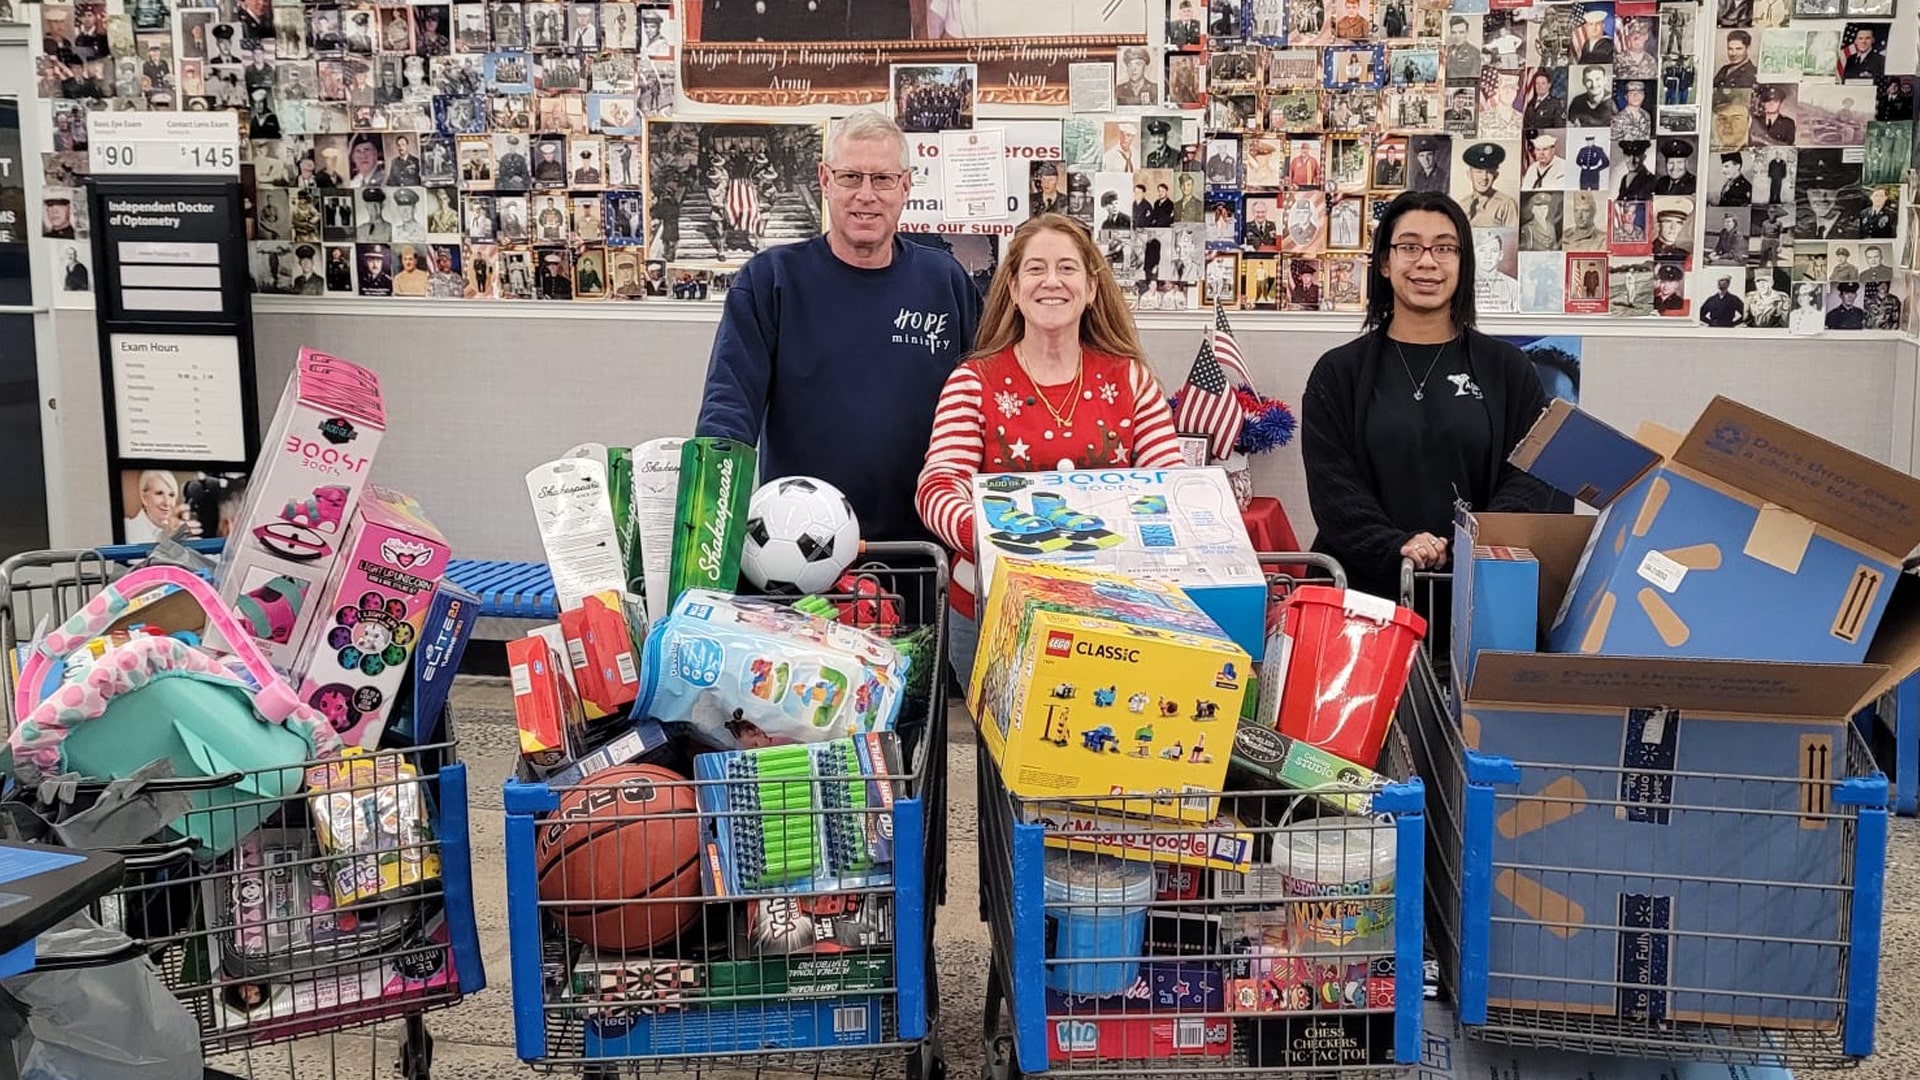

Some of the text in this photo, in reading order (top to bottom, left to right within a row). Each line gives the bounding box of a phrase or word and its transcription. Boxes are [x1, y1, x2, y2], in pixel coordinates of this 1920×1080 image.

[689, 49, 893, 72] Major Larry J. Bauguess, Jr.
[966, 43, 1087, 68] Chris Thompson
[769, 75, 812, 95] Army
[1007, 71, 1047, 93] Navy
[166, 120, 193, 129] Contact
[105, 146, 134, 166] 90
[191, 147, 234, 167] 145
[918, 142, 1061, 158] to eroes
[108, 200, 215, 214] Independent Doctor
[109, 214, 181, 229] of Optometry
[897, 222, 1014, 237] ave our supp
[894, 307, 950, 334] HOPE
[121, 341, 180, 353] Exam Hours
[892, 331, 951, 355] ministry
[641, 461, 681, 475] Shakesp
[1753, 437, 1910, 512] Don't throw away
[1759, 457, 1819, 488] chance
[1826, 485, 1844, 499] to
[538, 481, 600, 499] Shakespeare
[698, 457, 735, 581] Shakespeare
[359, 560, 385, 577] LIGHT
[395, 570, 433, 591] UNICORN
[422, 617, 455, 682] ELITE
[1049, 636, 1071, 650] LEGO
[1076, 641, 1141, 664] CLASSIC
[869, 737, 883, 774] REFILL
[1294, 757, 1335, 778] STUDIO
[880, 774, 893, 809] DAR
[1638, 773, 1651, 815] ontan
[1142, 829, 1208, 857] Doodle
[1635, 993, 1648, 1008] to
[1058, 1021, 1096, 1043] KID
[1304, 1026, 1345, 1039] CHESS
[1293, 1037, 1358, 1050] CHECKERS
